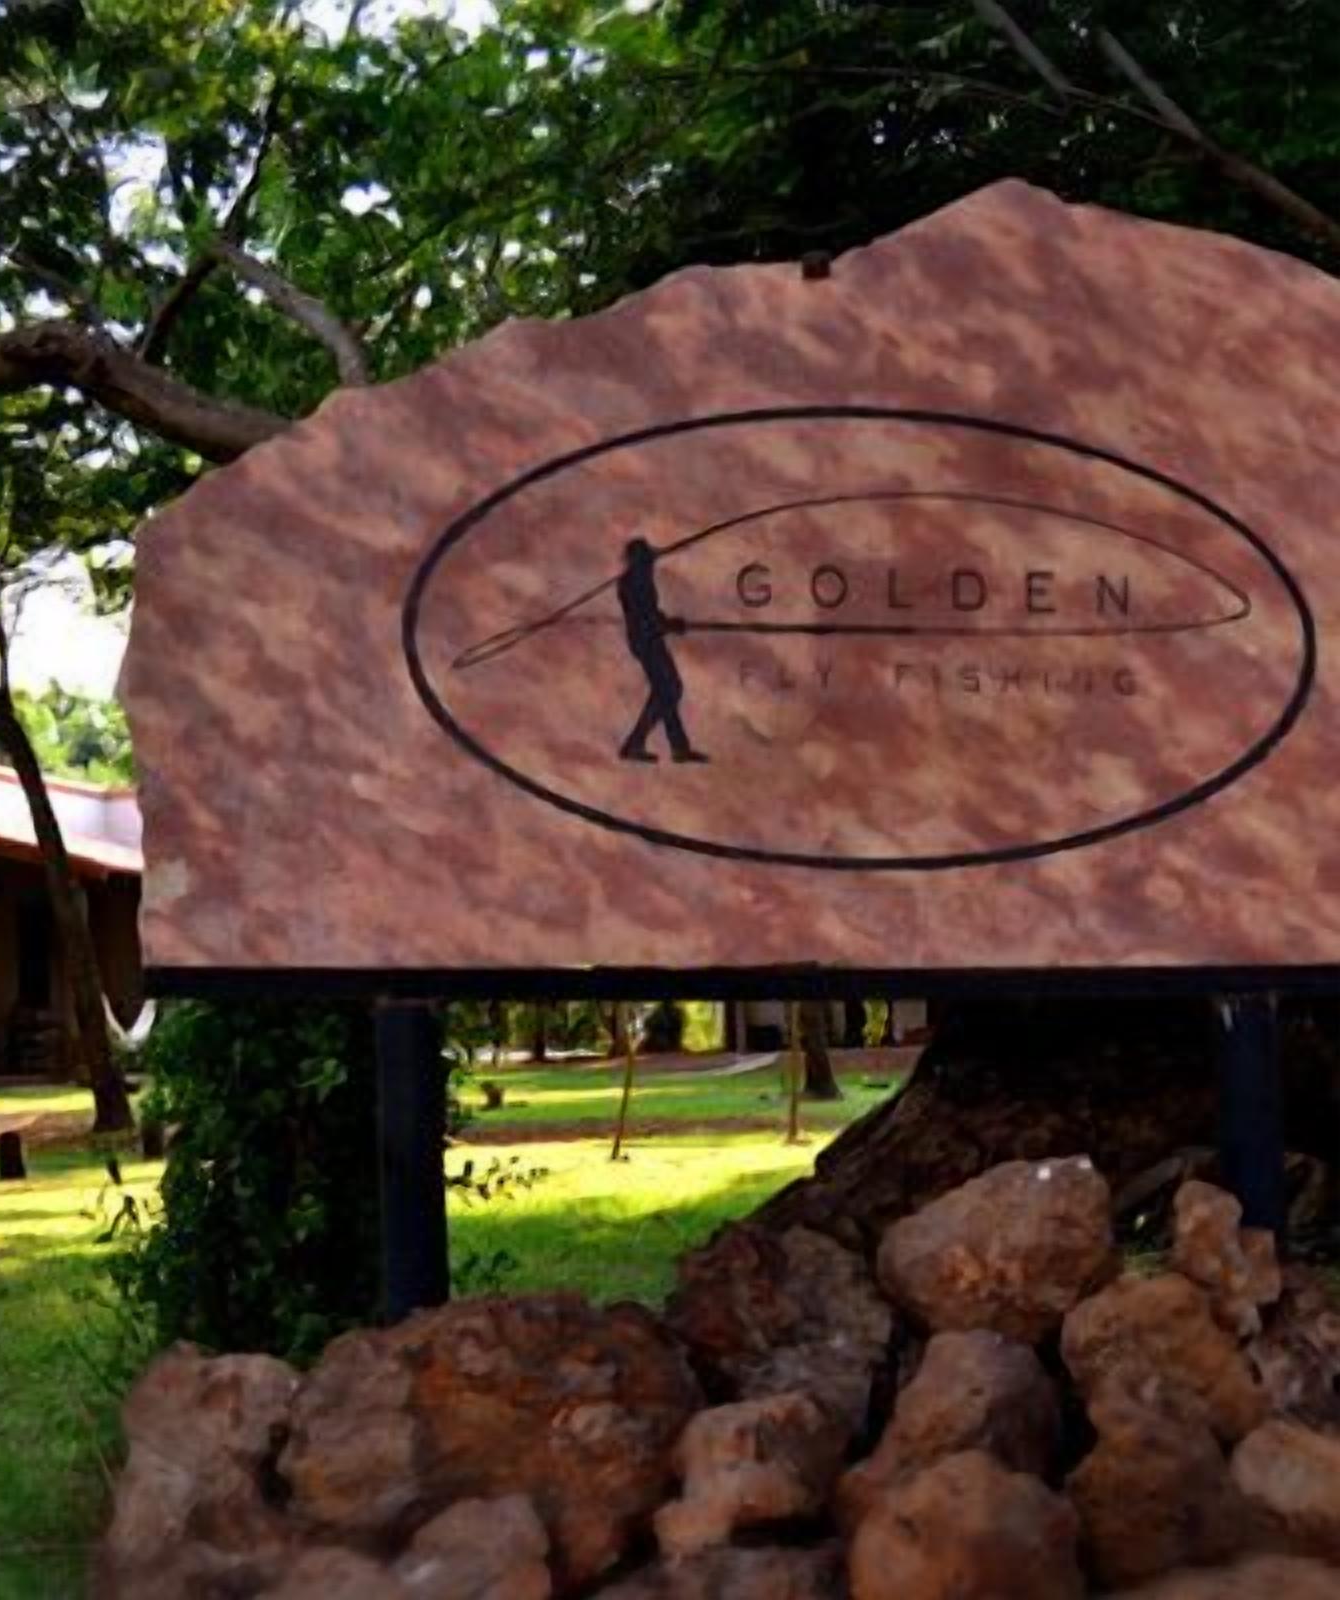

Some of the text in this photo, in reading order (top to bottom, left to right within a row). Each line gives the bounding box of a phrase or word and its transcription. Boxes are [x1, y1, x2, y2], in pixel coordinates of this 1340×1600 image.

[735, 562, 1130, 615] GOLDEN
[739, 661, 1137, 696] FLY FISHING
